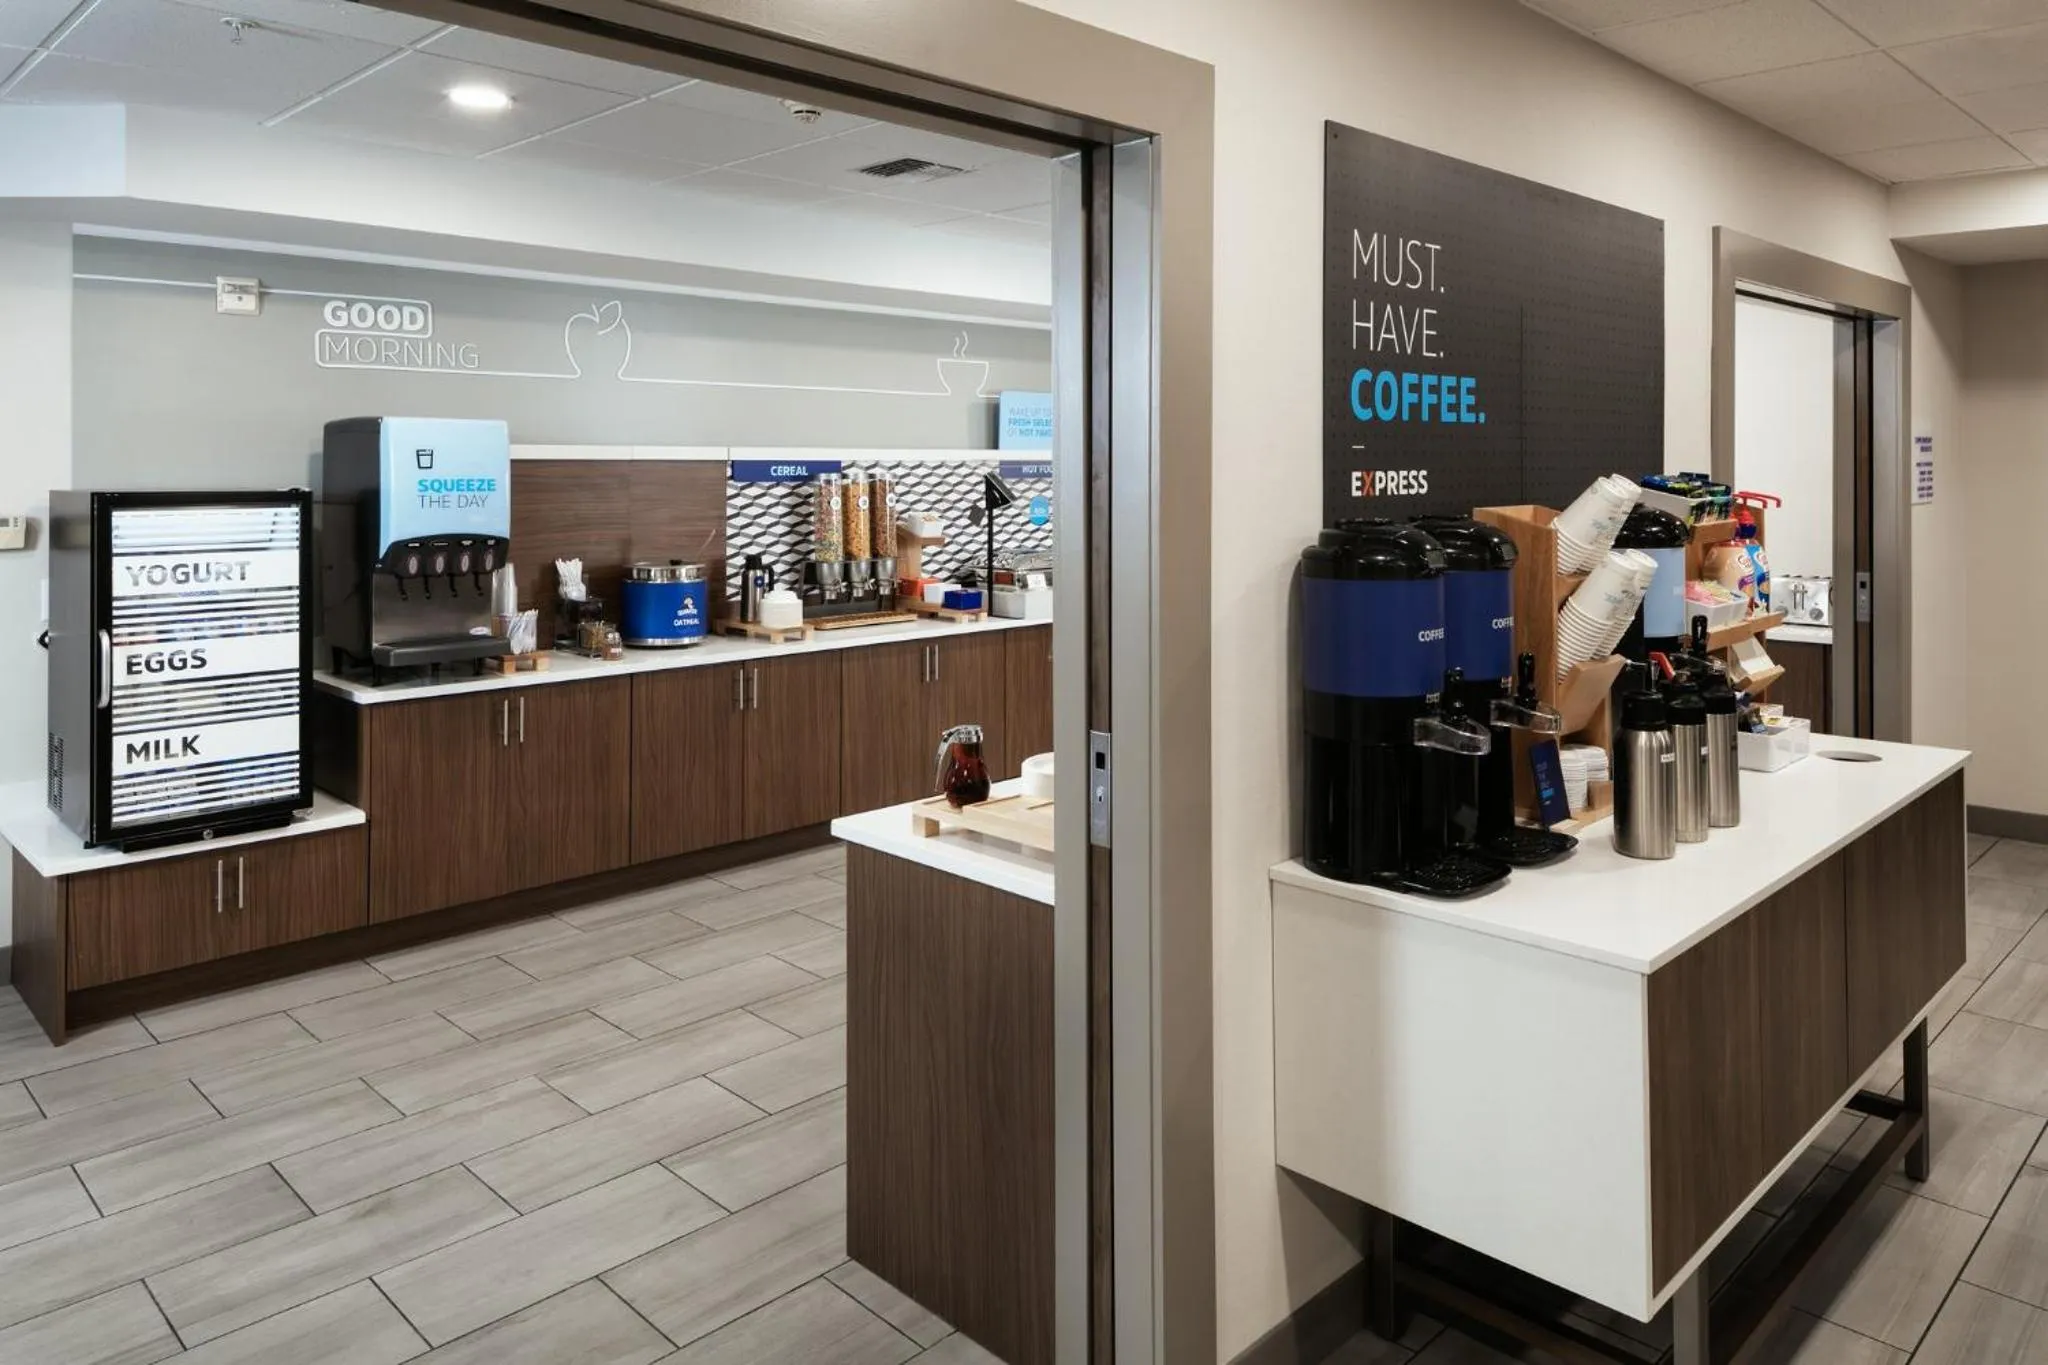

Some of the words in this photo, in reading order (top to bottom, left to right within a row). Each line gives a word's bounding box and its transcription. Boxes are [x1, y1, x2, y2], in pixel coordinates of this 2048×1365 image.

[1353, 228, 1445, 294] MUST.
[323, 300, 425, 331] GOOD
[1353, 298, 1444, 358] HAVE.
[325, 335, 480, 369] MORNING
[1350, 368, 1486, 424] COFFEE.
[417, 478, 496, 493] SQUEEZE
[770, 466, 808, 476] CEREAL
[1351, 469, 1428, 497] EXPRESS
[417, 494, 451, 509] THE
[457, 494, 488, 509] DAY
[125, 561, 251, 587] YOGURT
[126, 648, 207, 676] EGGS
[126, 734, 201, 765] MILK
